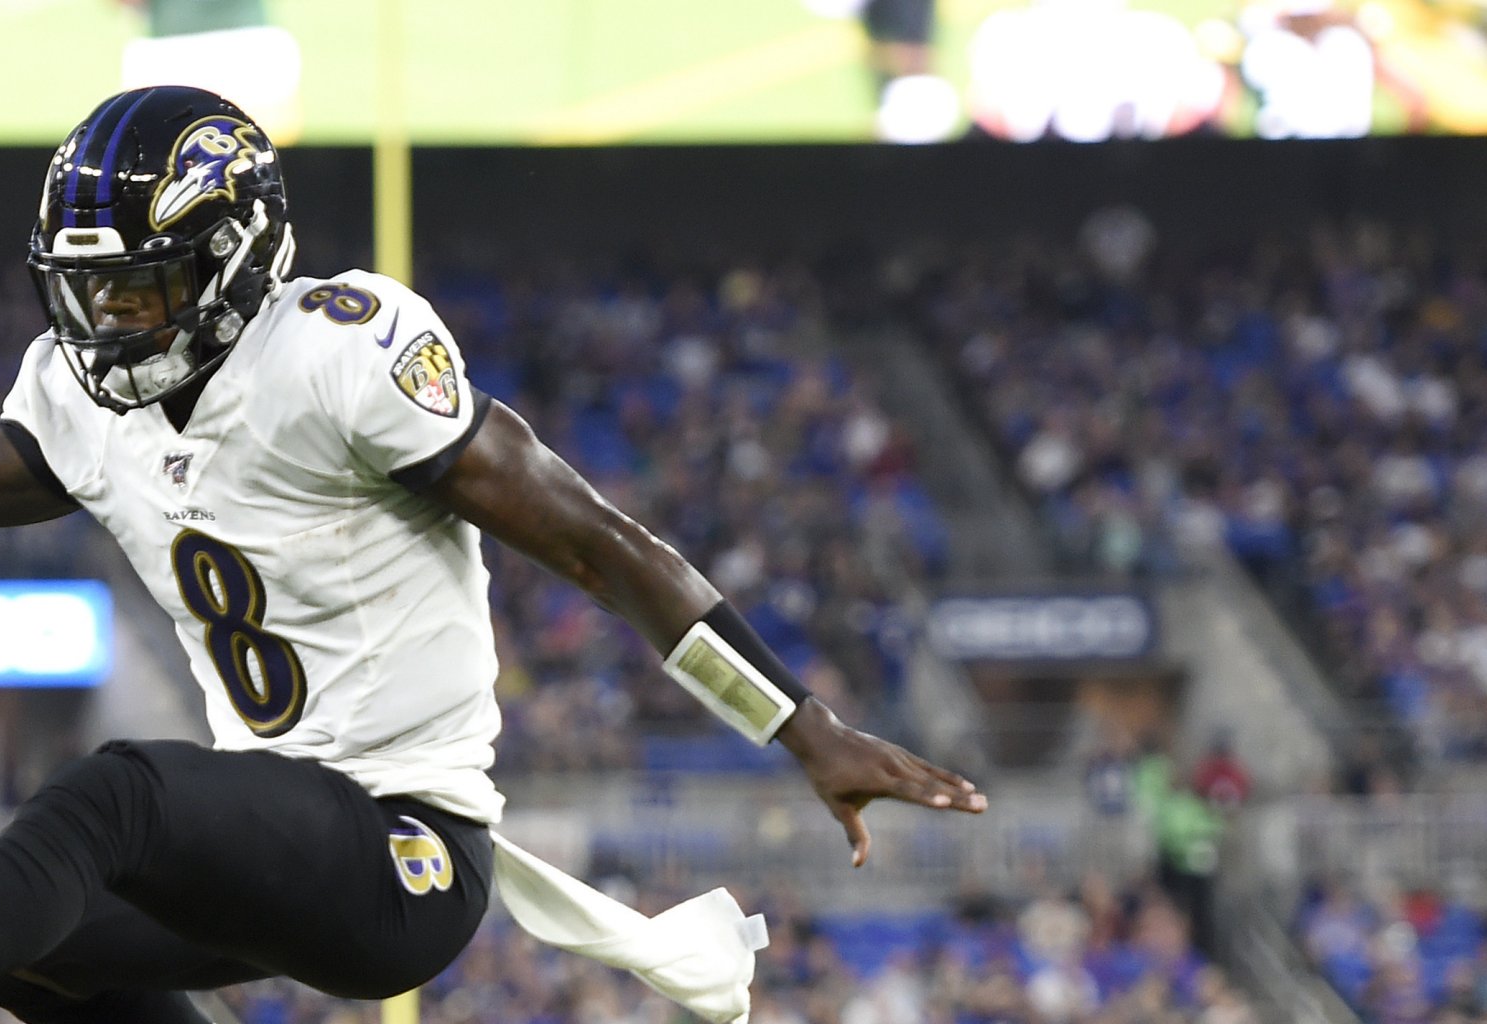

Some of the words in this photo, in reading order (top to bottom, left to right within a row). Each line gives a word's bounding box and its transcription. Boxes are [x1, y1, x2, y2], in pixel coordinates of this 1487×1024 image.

[297, 283, 382, 325] 8
[162, 510, 216, 522] RAVENS
[170, 527, 308, 738] 8
